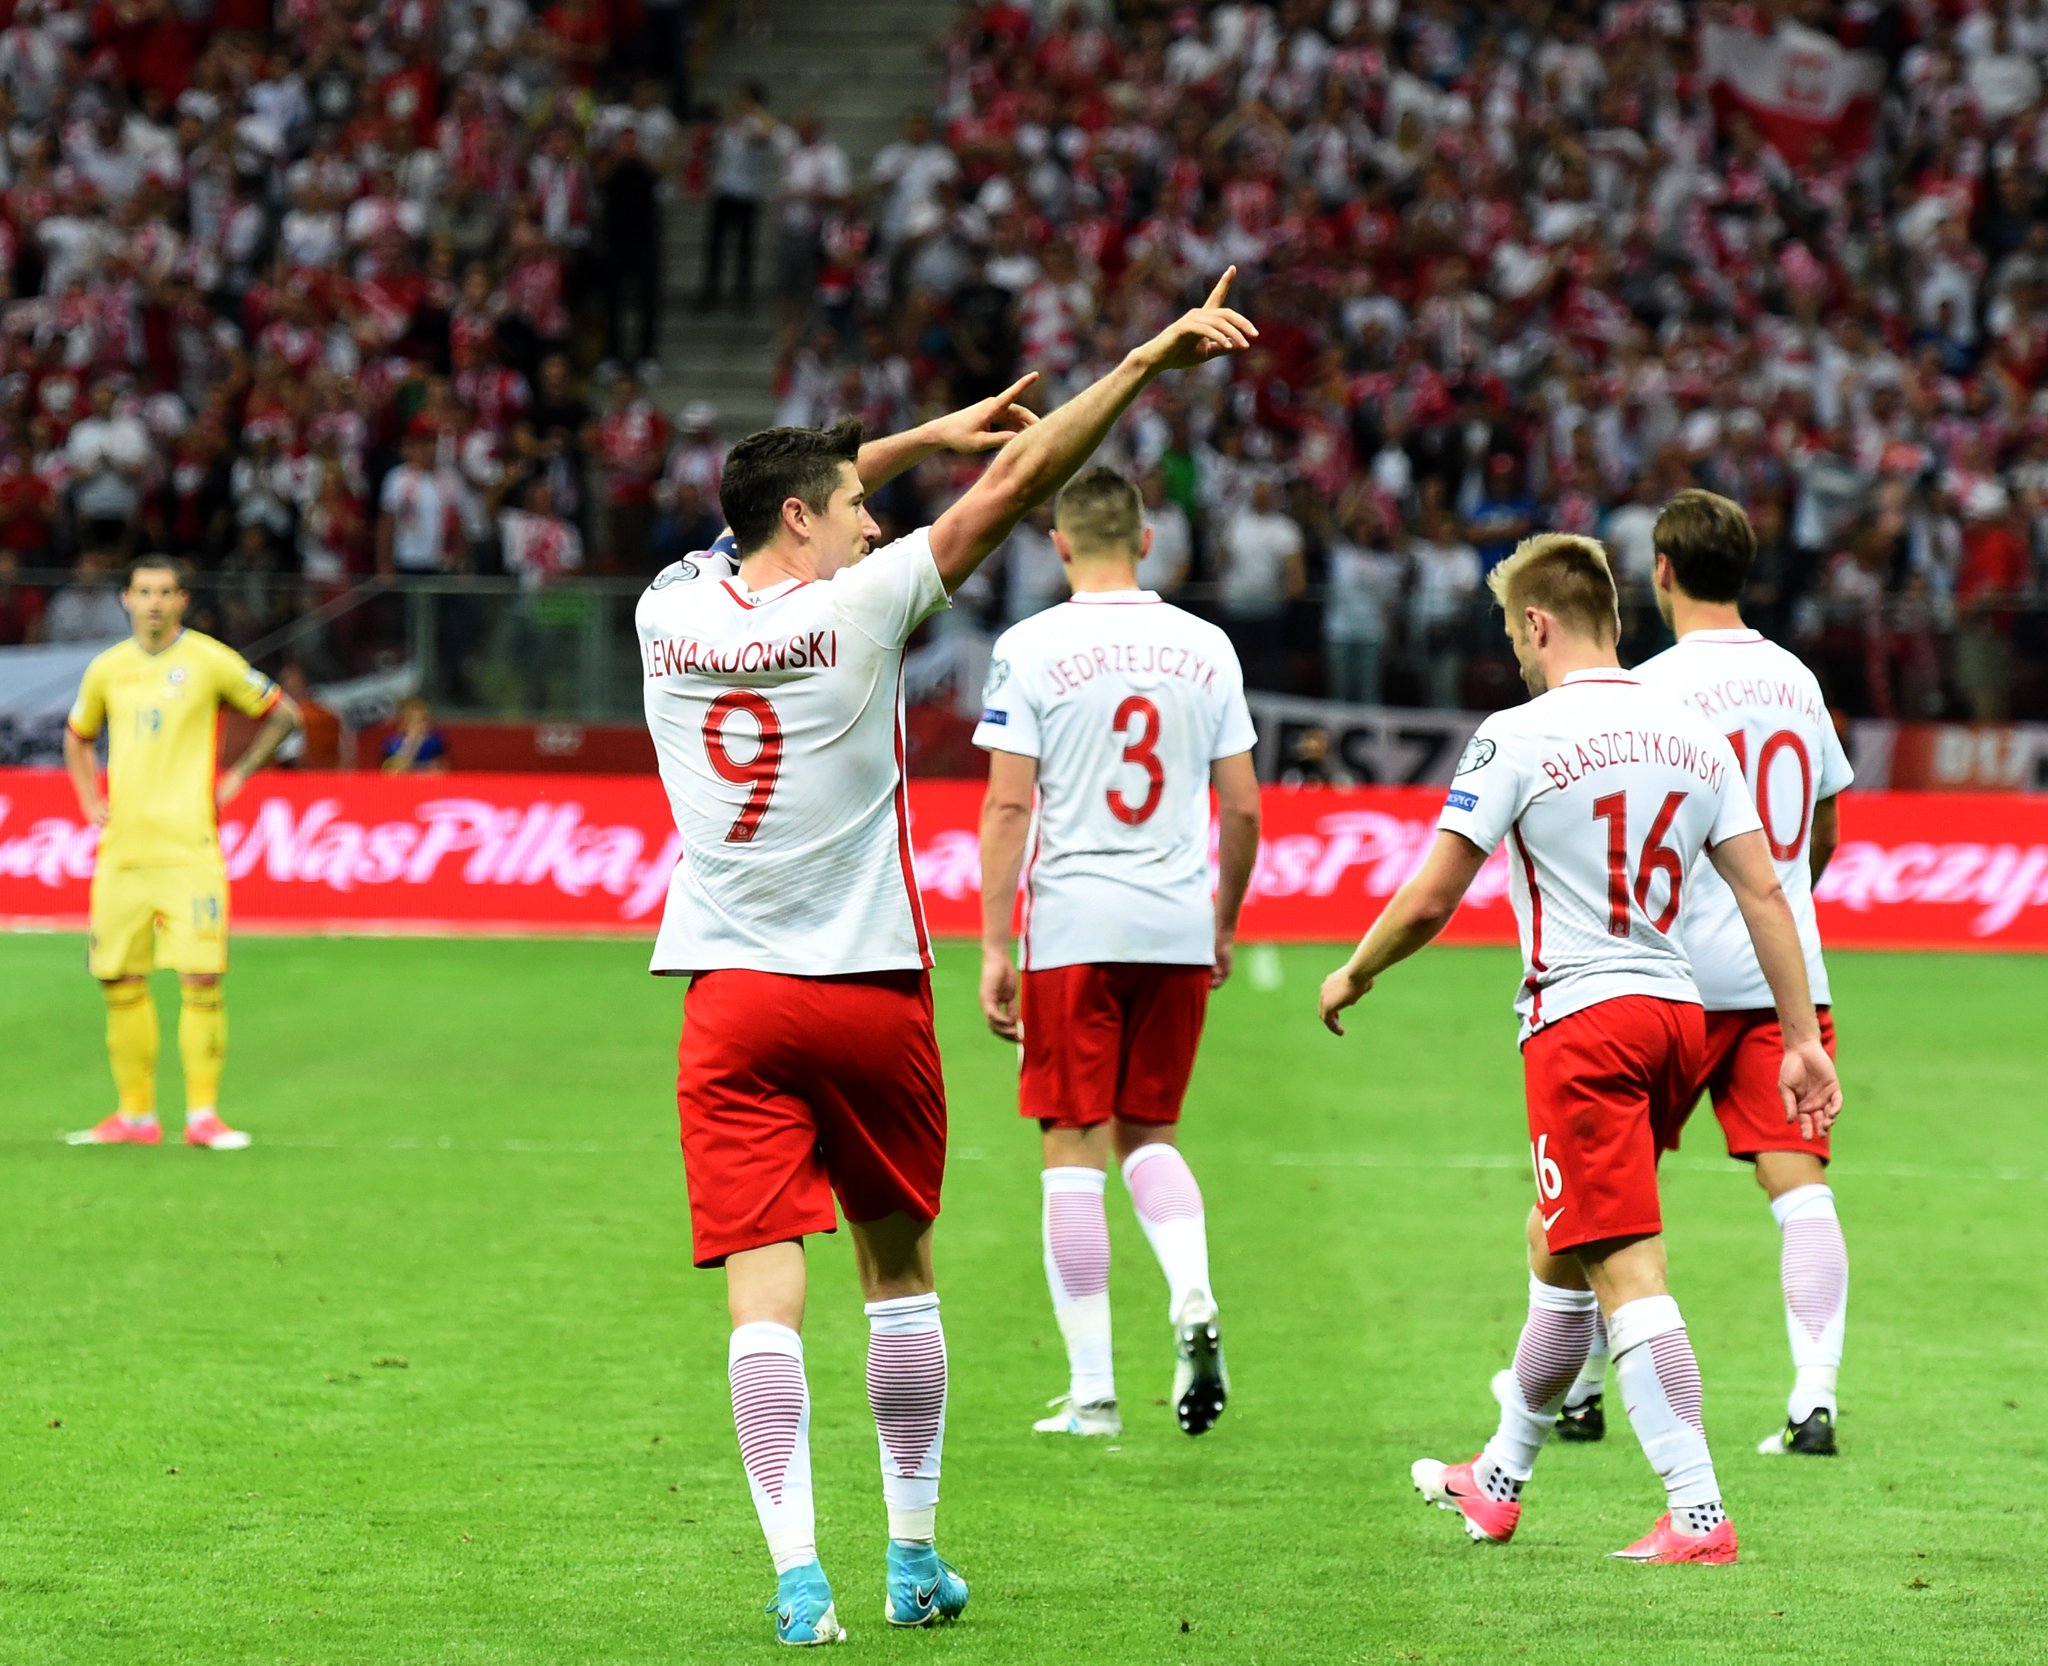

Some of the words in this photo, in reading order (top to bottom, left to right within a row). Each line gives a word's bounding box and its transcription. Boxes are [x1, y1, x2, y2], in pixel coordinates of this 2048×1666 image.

[701, 687, 783, 843] 9
[1106, 695, 1163, 826] 3
[1542, 731, 1725, 795] BŁASZCZYKOWSKI
[1684, 679, 1823, 726] RYCHOWIA
[1593, 790, 1688, 938] 16
